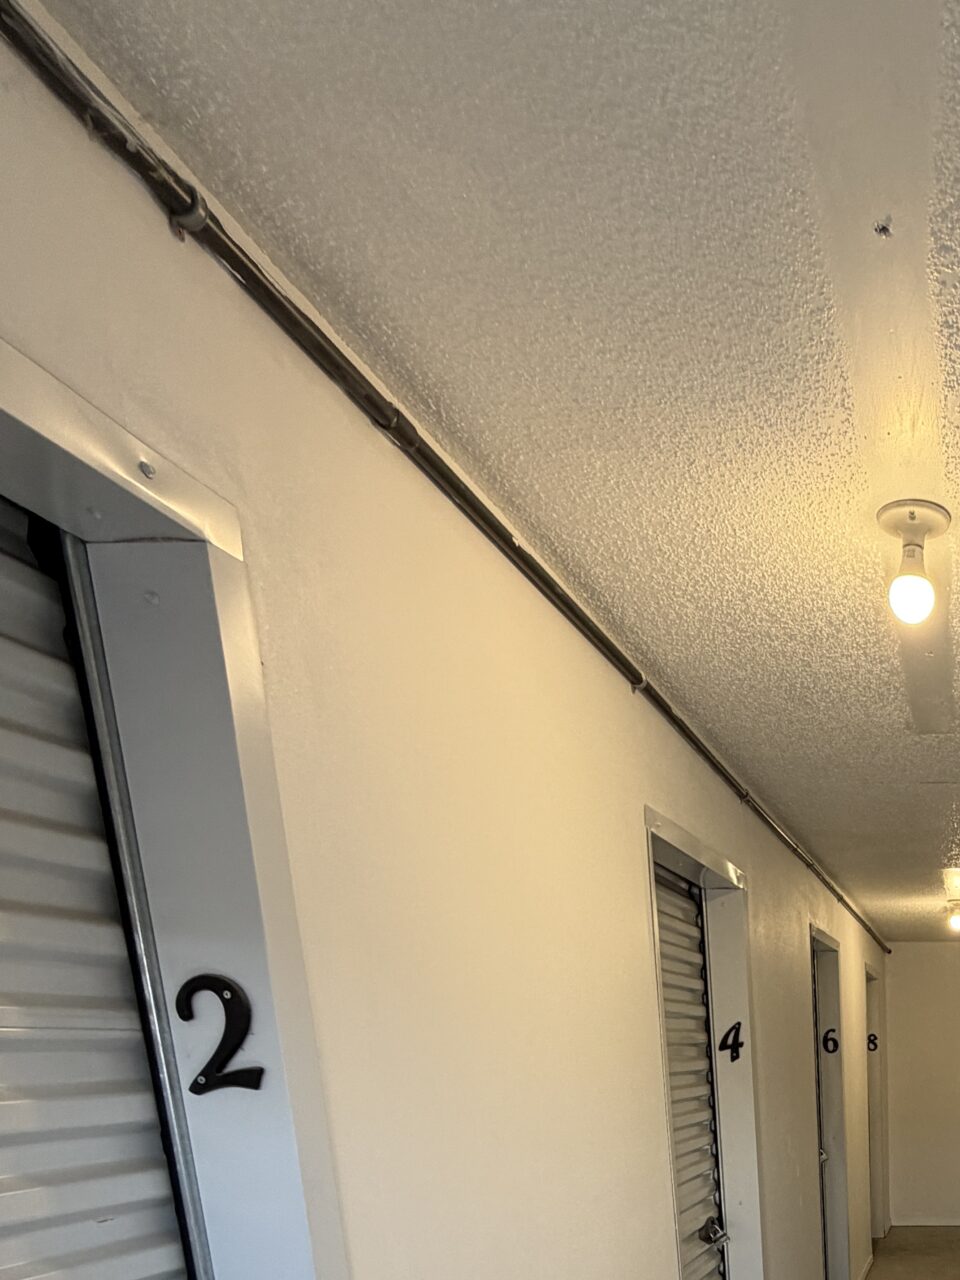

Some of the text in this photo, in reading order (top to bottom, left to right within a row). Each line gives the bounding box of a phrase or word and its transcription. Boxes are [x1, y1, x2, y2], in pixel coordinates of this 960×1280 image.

[175, 973, 265, 1096] 2
[718, 1021, 744, 1063] 4
[822, 1028, 839, 1054] 6
[867, 1033, 878, 1052] 8
